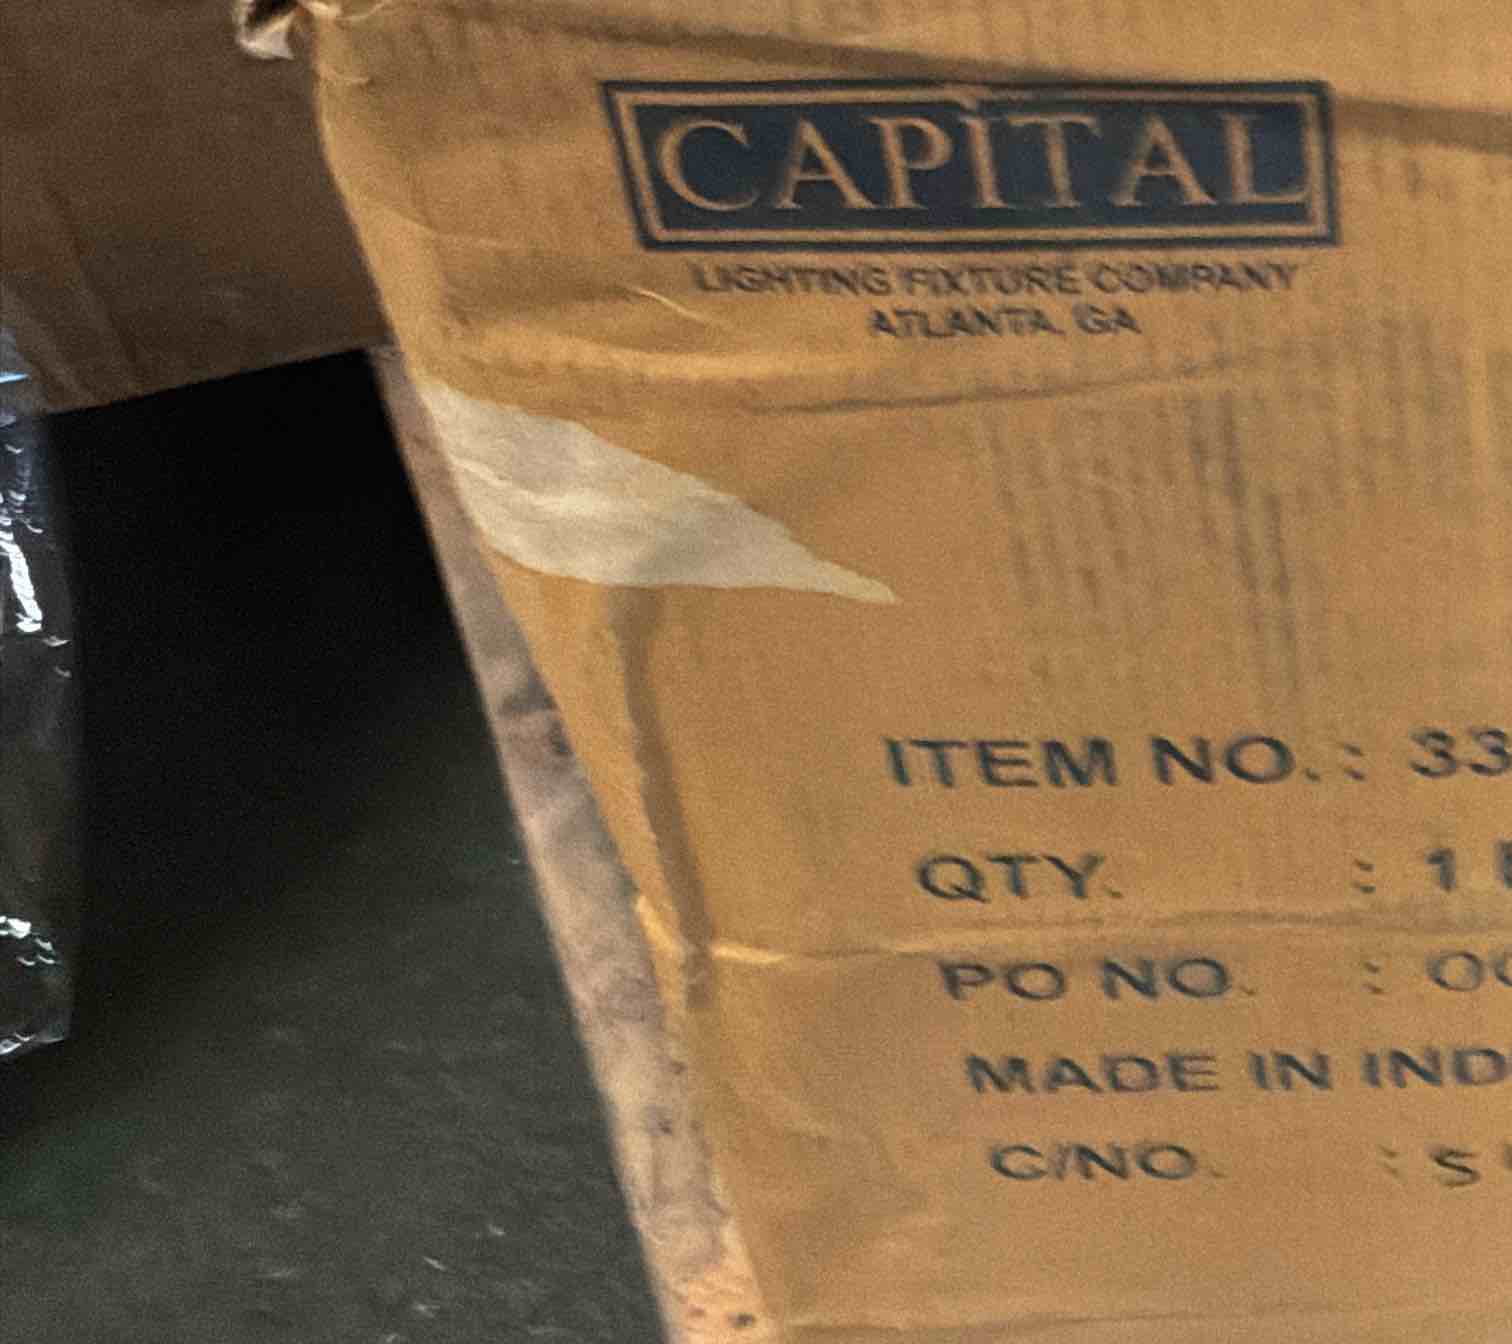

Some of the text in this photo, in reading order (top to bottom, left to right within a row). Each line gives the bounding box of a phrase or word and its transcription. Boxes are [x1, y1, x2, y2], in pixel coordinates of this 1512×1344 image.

[656, 112, 1308, 212] CAPITAL
[692, 261, 1298, 296] LIGHTING FIXTURE COMPANY
[1073, 304, 1143, 335] GA
[884, 736, 1119, 788] ITEM
[916, 852, 1124, 904] QTY.
[1423, 846, 1458, 893] 1
[939, 959, 1067, 1002] PO
[1101, 956, 1258, 1001] NO.
[964, 1053, 1221, 1095] MADE
[1249, 1050, 1334, 1091] IN
